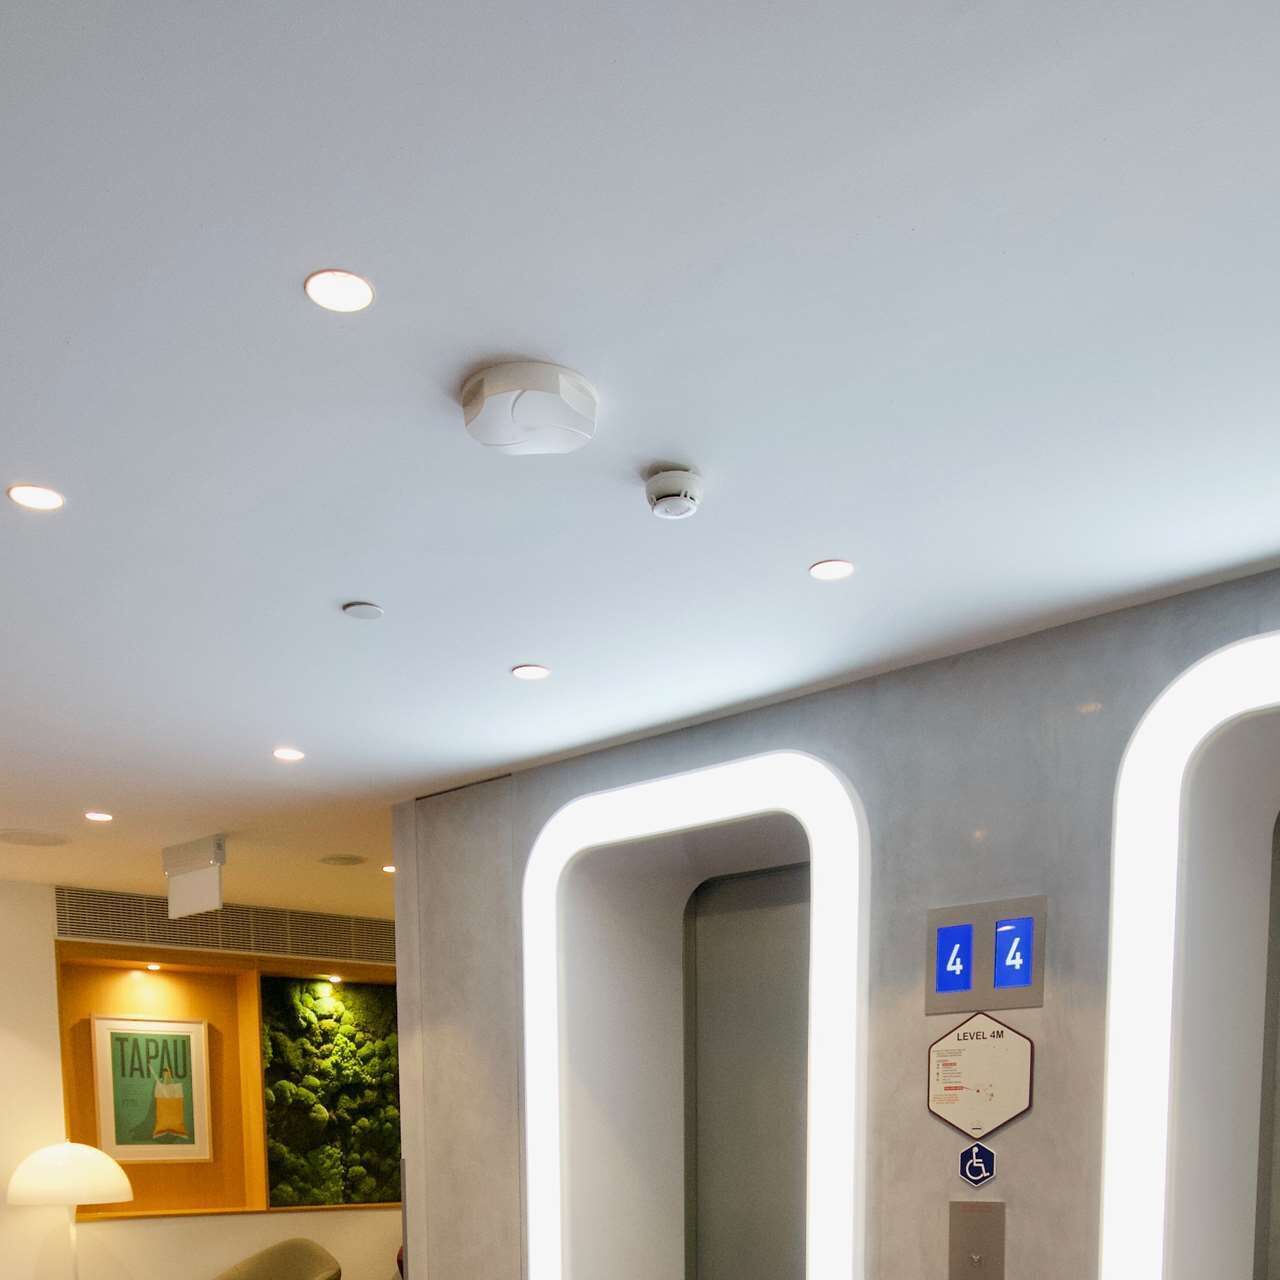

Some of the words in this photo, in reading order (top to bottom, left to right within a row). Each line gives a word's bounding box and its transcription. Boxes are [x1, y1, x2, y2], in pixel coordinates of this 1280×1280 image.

[946, 943, 963, 975] 4
[1005, 936, 1023, 970] 4
[956, 1031, 988, 1041] LEVEL
[989, 1030, 1005, 1039] 4M
[114, 1036, 188, 1079] TAPAU
